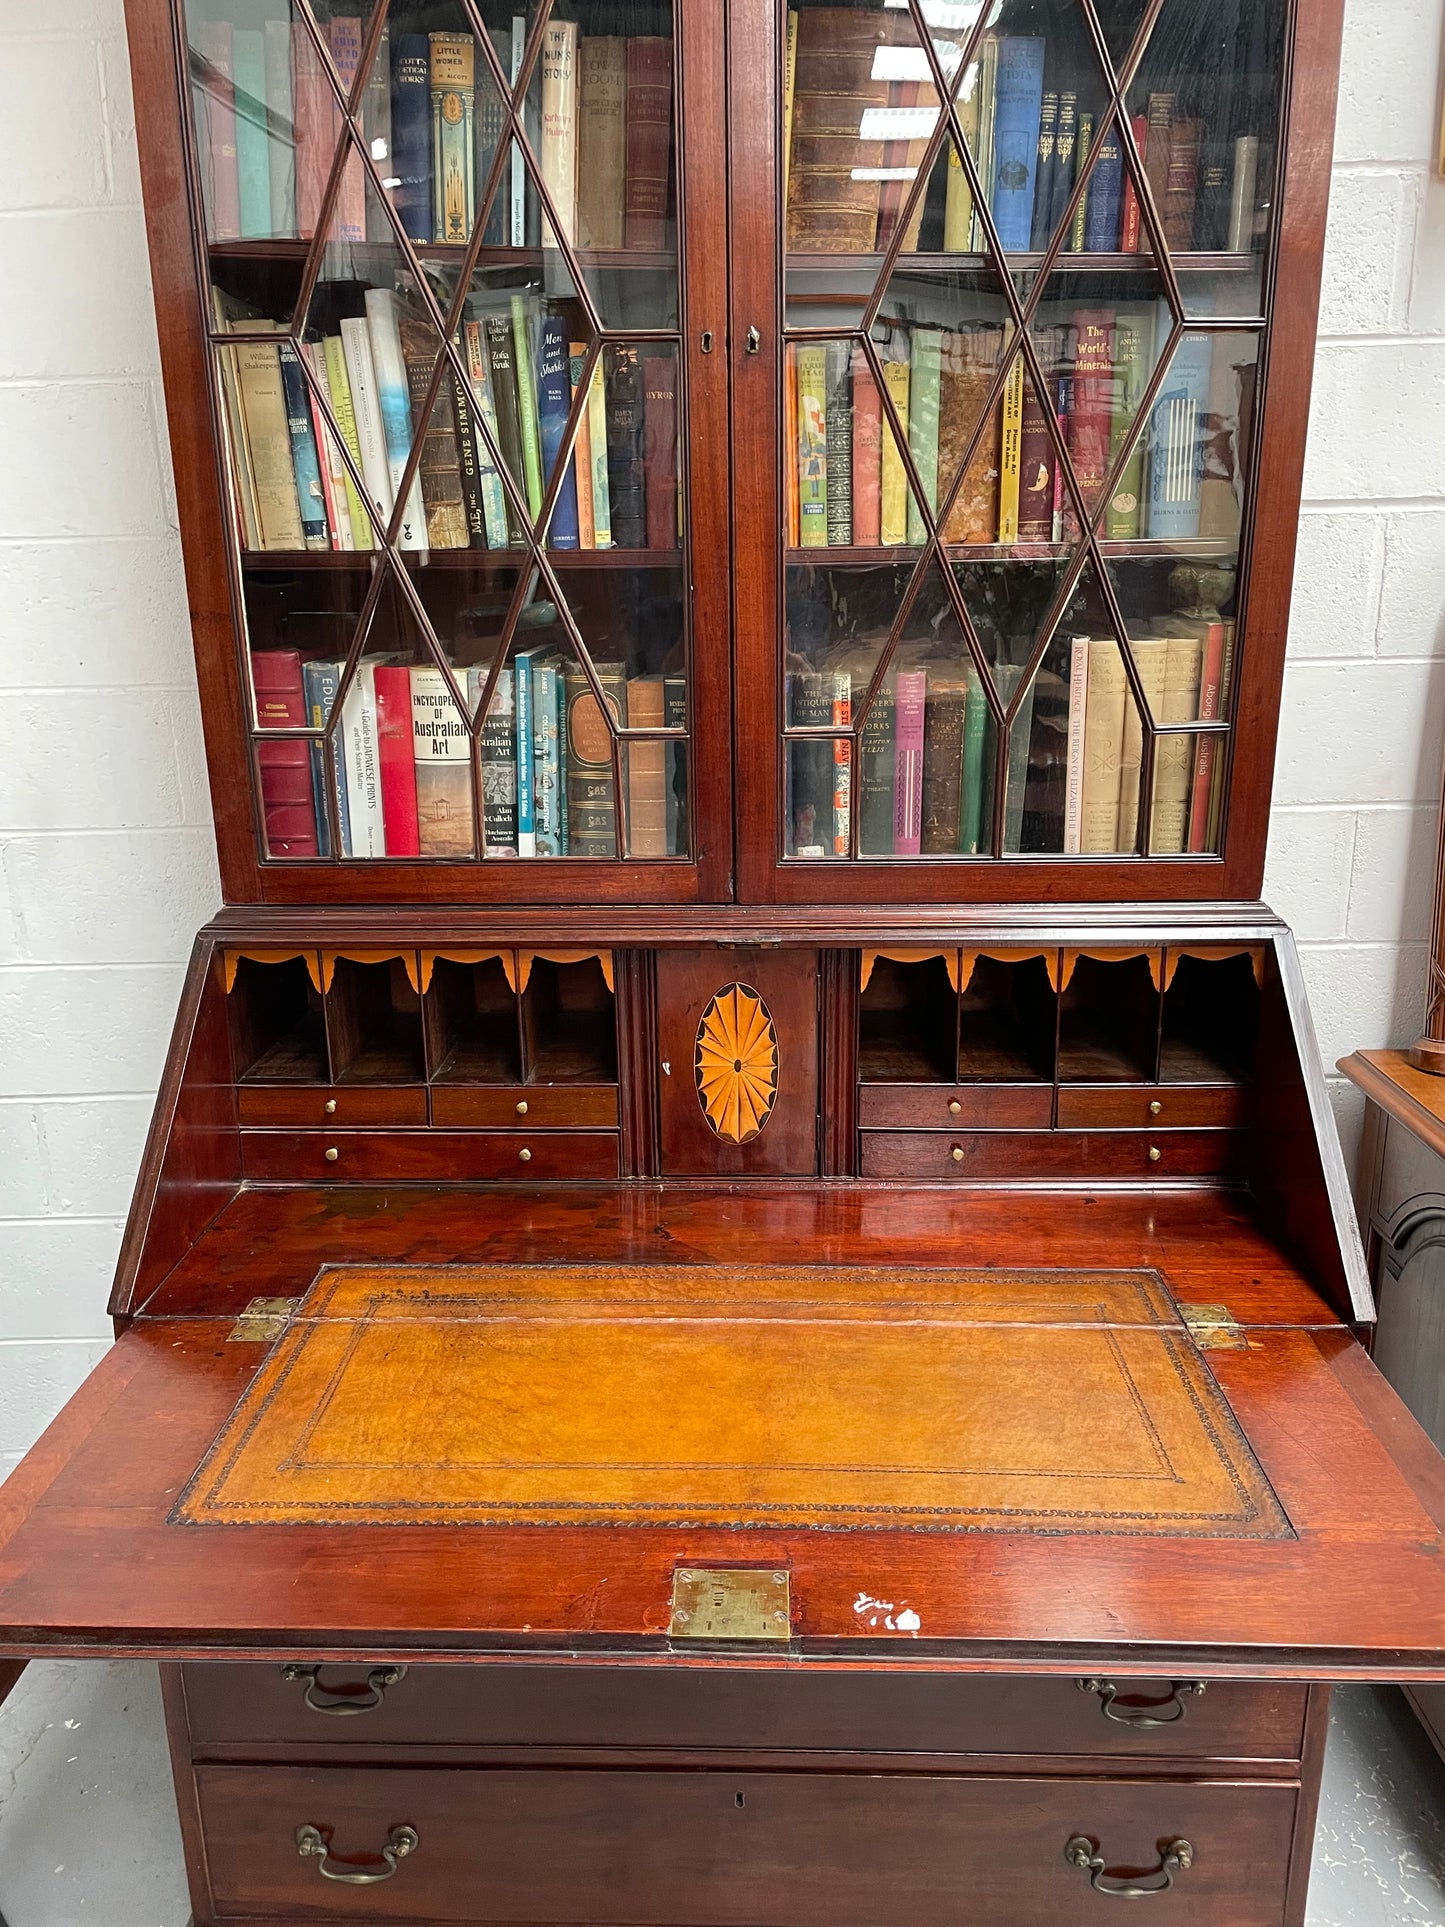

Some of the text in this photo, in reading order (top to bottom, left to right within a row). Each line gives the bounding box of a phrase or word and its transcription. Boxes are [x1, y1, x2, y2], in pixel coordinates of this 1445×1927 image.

[549, 31, 566, 42] THE
[436, 47, 462, 55] LITTLE
[435, 58, 463, 66] WOMEN
[1086, 326, 1104, 337] The
[541, 333, 563, 349] Men
[1077, 342, 1111, 354] World's
[546, 347, 561, 359] and
[318, 355, 327, 378] Helen
[540, 360, 566, 378] Sharks
[1074, 360, 1112, 371] Minerals
[646, 391, 674, 400] BYRON
[462, 440, 474, 476] GENE
[1074, 646, 1083, 673] ROYAL
[841, 687, 849, 707] THE
[1073, 673, 1083, 713] HERITAGE
[519, 692, 527, 718] Australian
[809, 709, 830, 717] MAN
[434, 709, 443, 719] OF
[362, 715, 371, 736] Guide
[414, 720, 467, 737] Australian
[501, 729, 510, 737] of
[432, 739, 449, 755] Art
[495, 747, 511, 756] Art
[841, 742, 849, 769] NAVY
[1071, 738, 1080, 763] REIGN
[1199, 734, 1211, 776] Australia
[364, 744, 374, 782] JAPANESE
[1070, 765, 1079, 776] OF
[356, 772, 364, 790] Matter
[367, 783, 376, 810] PRINTS
[1069, 777, 1079, 822] ELIZABETH
